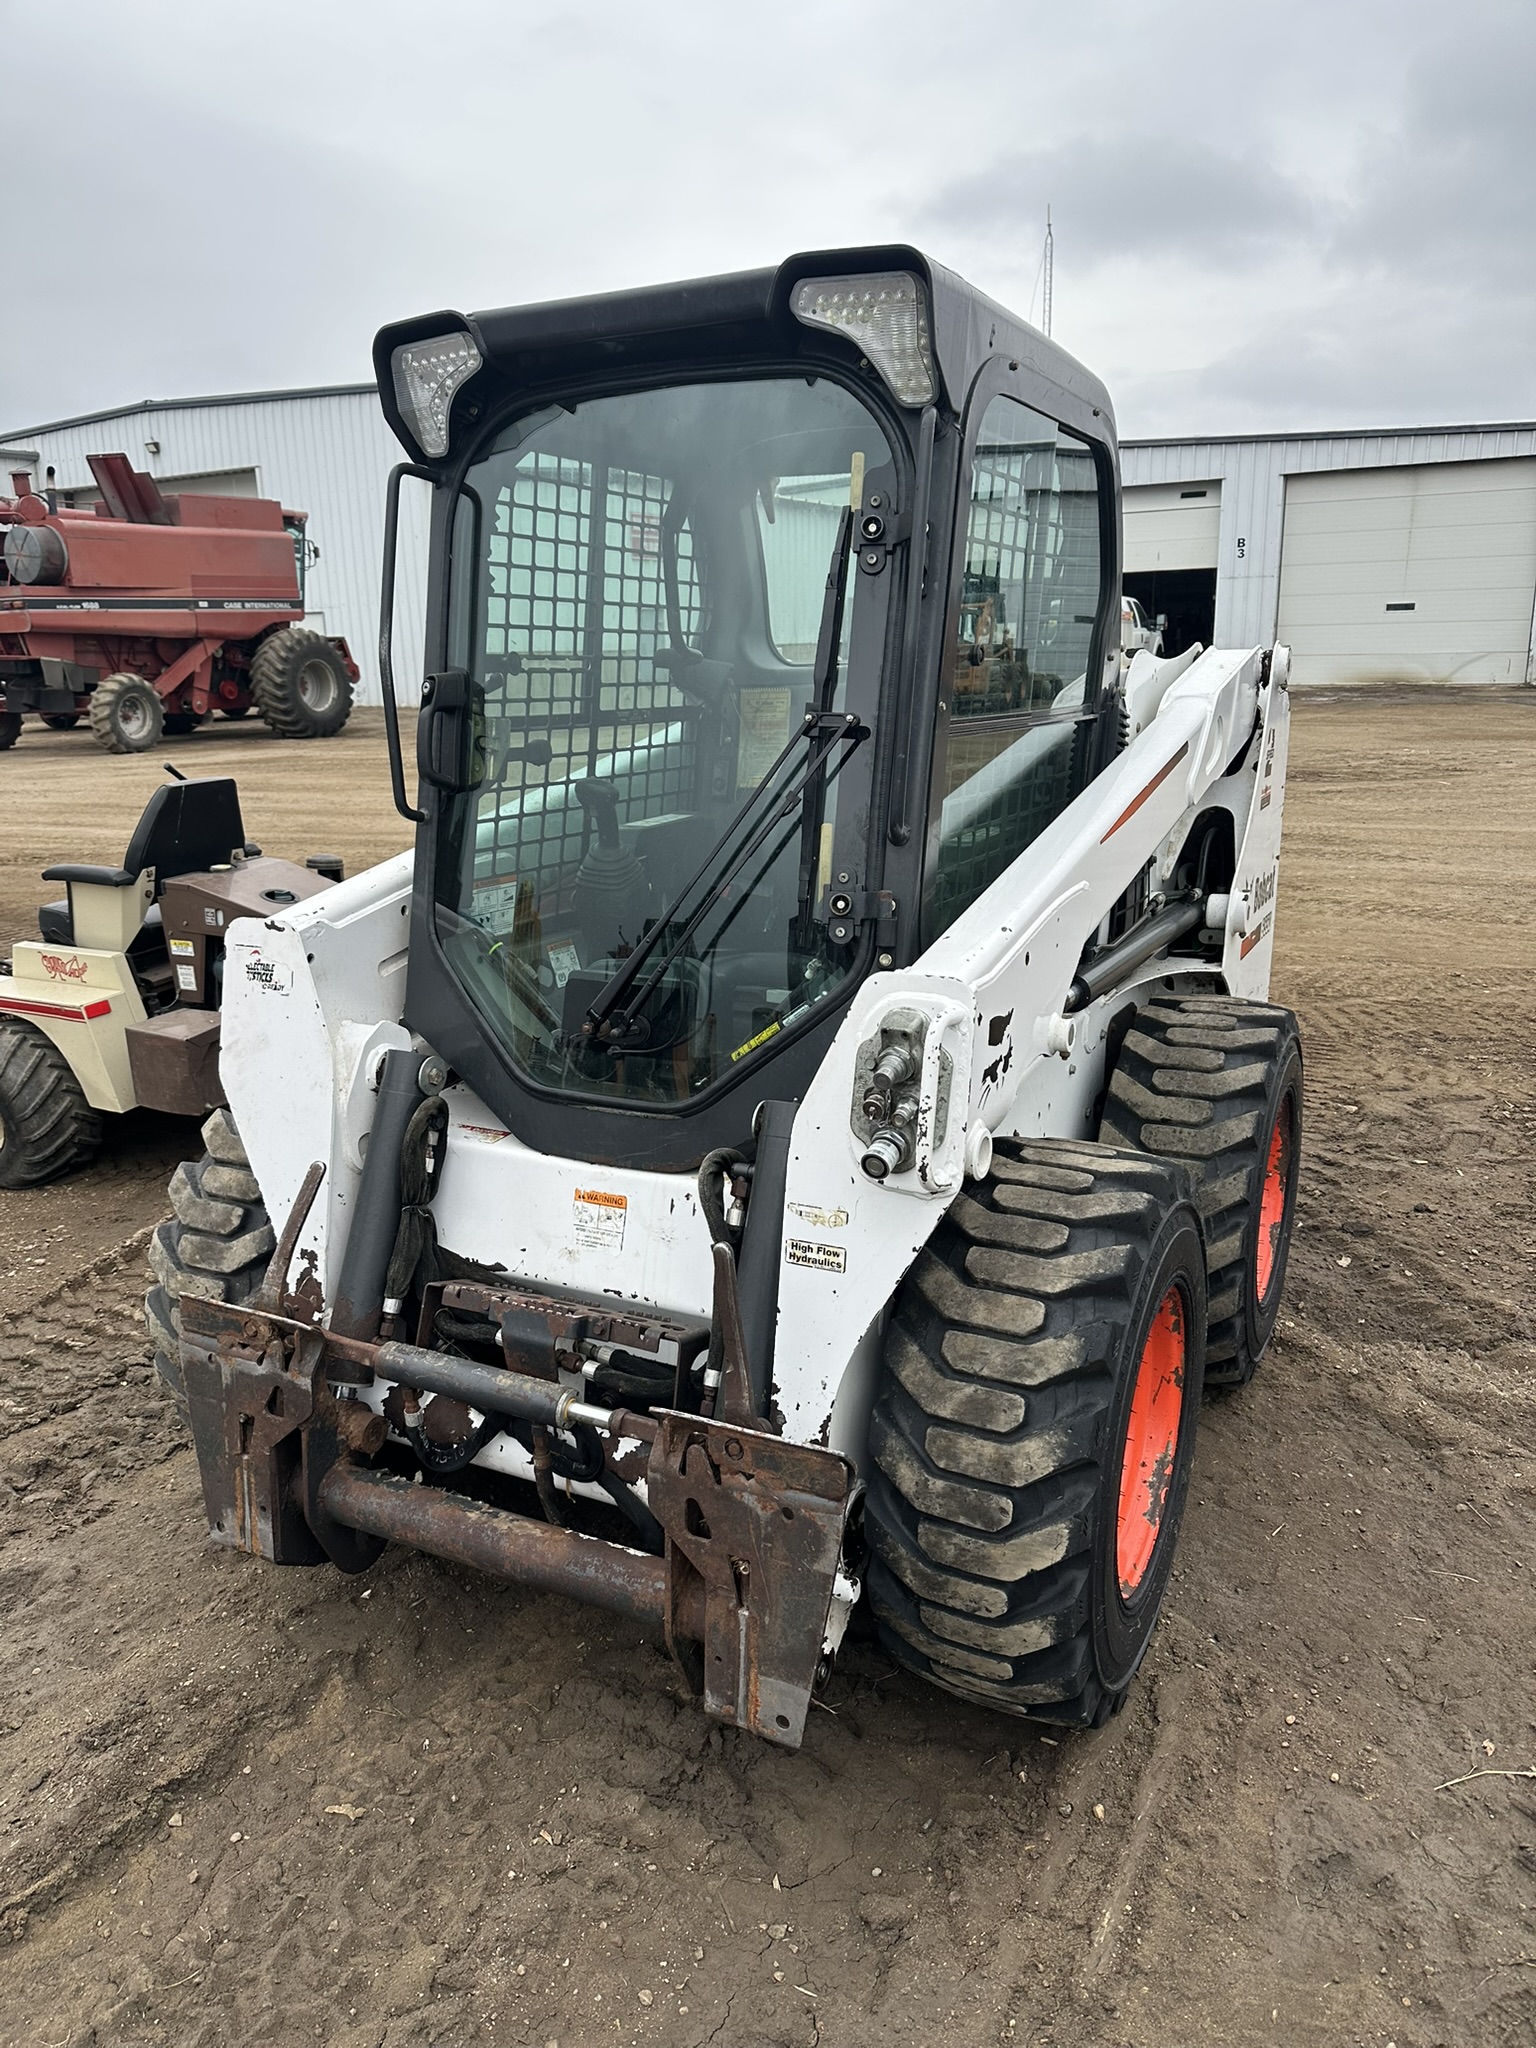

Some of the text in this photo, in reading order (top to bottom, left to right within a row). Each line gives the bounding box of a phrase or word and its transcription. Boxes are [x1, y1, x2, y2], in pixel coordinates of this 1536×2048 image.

[1237, 538, 1246, 548] B
[223, 601, 292, 610] CASE INTERNATIONAL
[1253, 865, 1276, 914] Bobcat
[586, 1192, 624, 1206] WARNING
[791, 1241, 840, 1258] High Flow
[788, 1251, 842, 1269] Hydraulics
